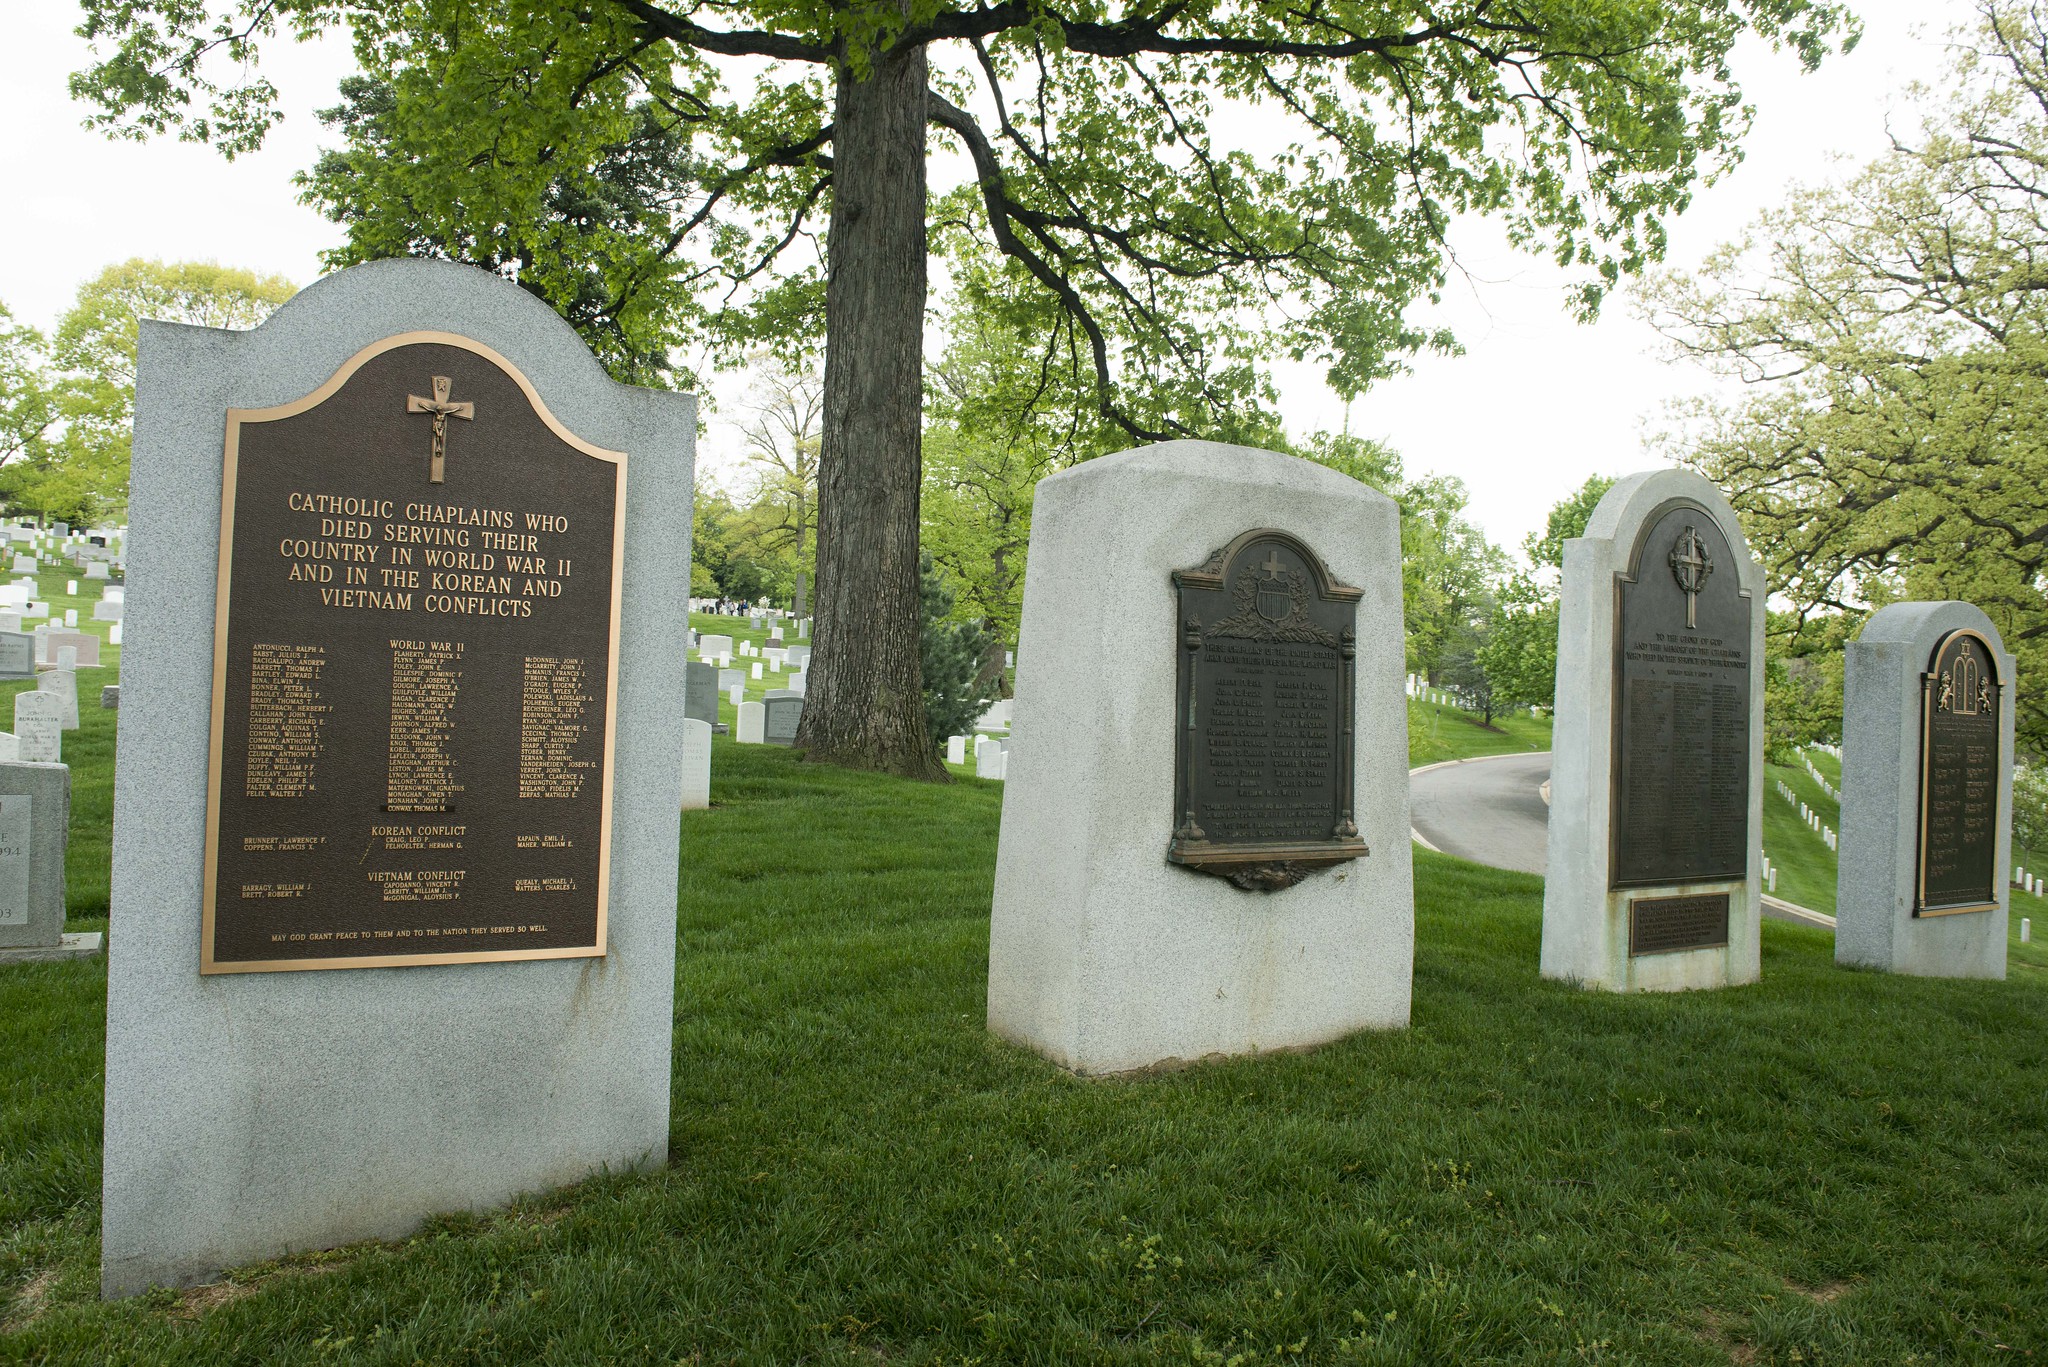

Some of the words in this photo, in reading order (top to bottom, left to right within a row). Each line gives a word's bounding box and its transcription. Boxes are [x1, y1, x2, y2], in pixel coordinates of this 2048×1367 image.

[289, 491, 392, 519] CATHOLIC
[406, 502, 513, 529] CHAPLAINS
[525, 513, 568, 534] WHO
[321, 517, 371, 540] DIED
[384, 523, 469, 548] SERVING
[481, 531, 538, 554] THEIR
[279, 537, 379, 563] COUNTRY
[391, 546, 412, 566] IN
[423, 548, 495, 572] WORLD
[505, 555, 546, 576] WAR
[557, 559, 571, 578] II
[288, 561, 333, 582] AND
[346, 565, 368, 585] IN
[379, 568, 420, 588] THE
[431, 571, 511, 595] KOREAN
[522, 578, 562, 598] AND
[320, 586, 412, 610] VIETNAM
[424, 593, 531, 618] CONFLICTS
[389, 639, 425, 650] WORLD
[430, 641, 451, 651] WAR
[456, 643, 464, 652] II
[371, 826, 412, 835] KOREAN
[417, 826, 466, 835] CONFLICT
[367, 871, 412, 881] VIETNAM
[417, 870, 465, 880] CONFLICT
